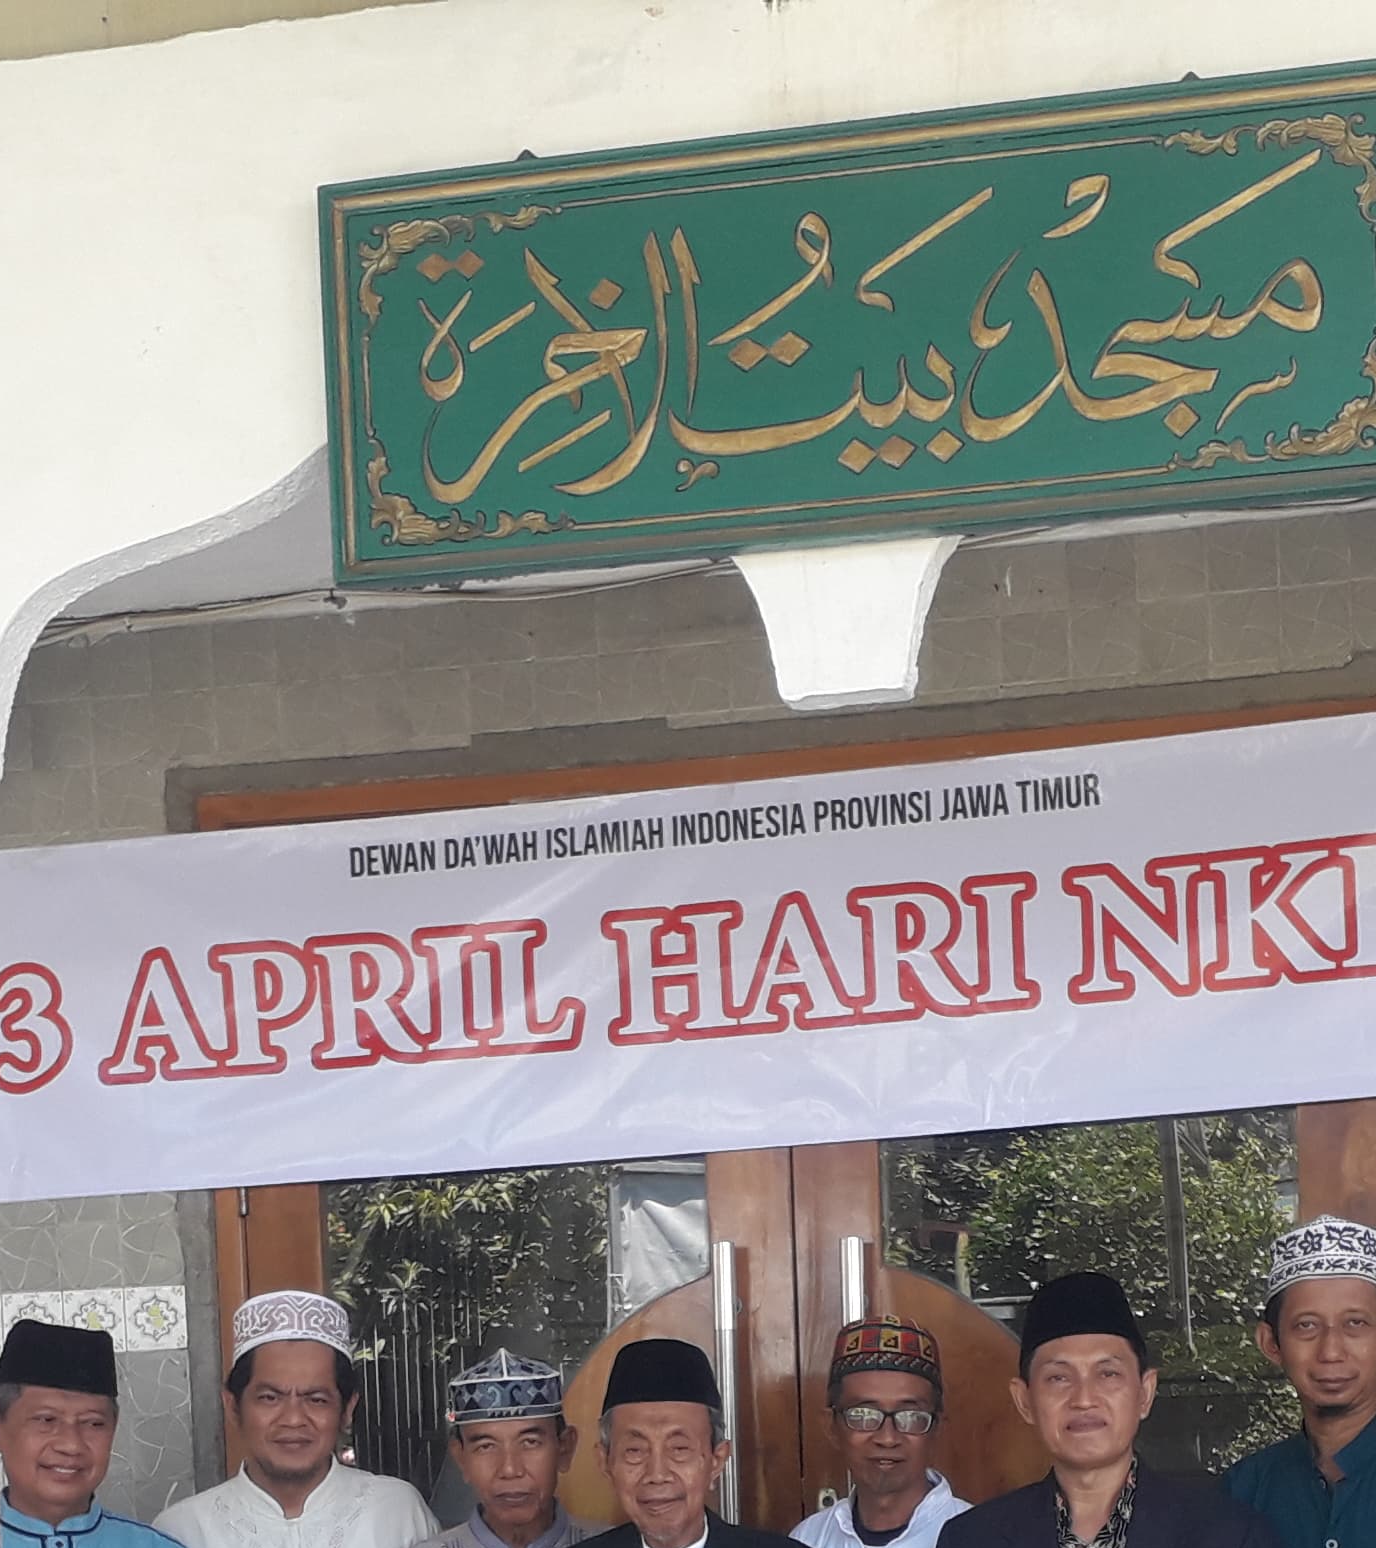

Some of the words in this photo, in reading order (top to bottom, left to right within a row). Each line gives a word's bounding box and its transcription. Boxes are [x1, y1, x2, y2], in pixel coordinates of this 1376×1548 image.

[349, 840, 436, 878] DEWAN
[444, 830, 538, 870] DA'WAH
[546, 817, 664, 860] ISLAMIAH
[672, 803, 806, 847] INDONESIA
[813, 790, 932, 833] PROVINSI
[939, 783, 1009, 821] JAWA
[1015, 773, 1100, 814] TIMUR
[99, 918, 585, 1085] APRIL
[600, 870, 1040, 1046] HARI
